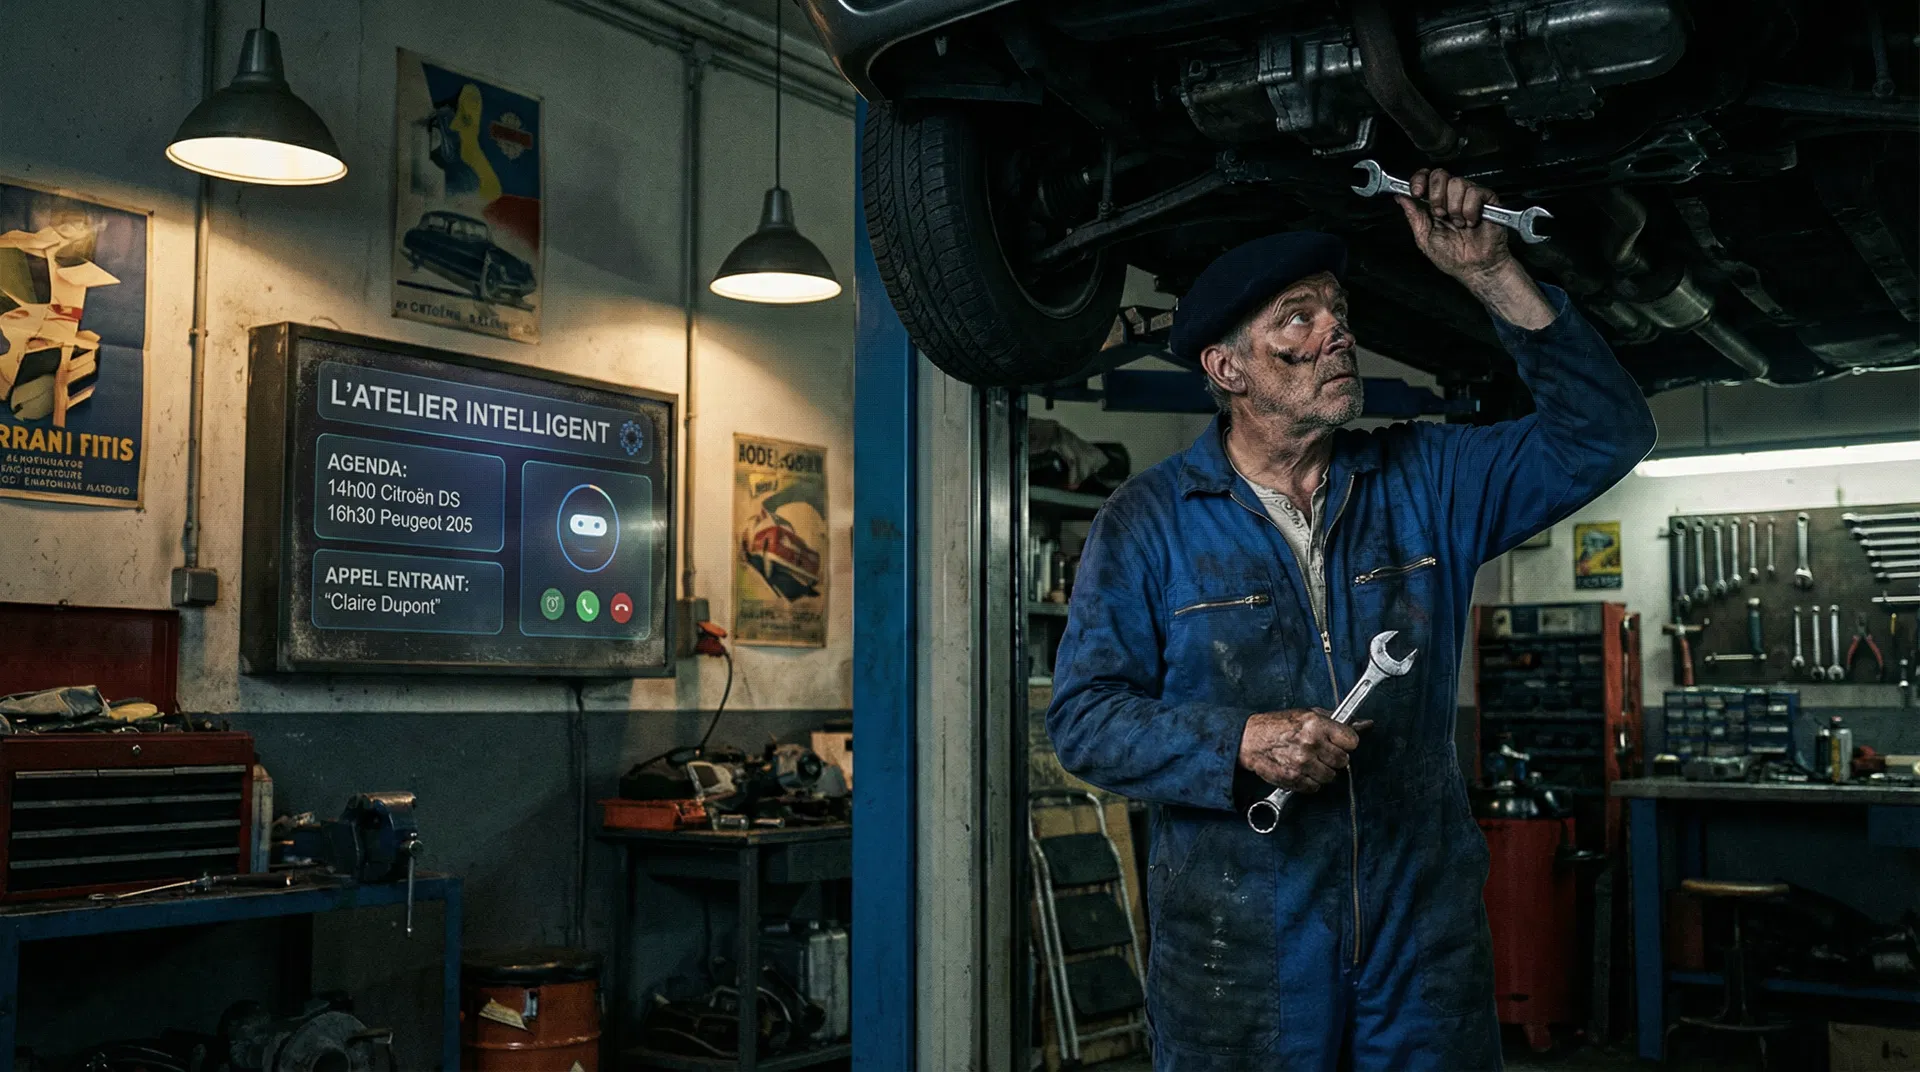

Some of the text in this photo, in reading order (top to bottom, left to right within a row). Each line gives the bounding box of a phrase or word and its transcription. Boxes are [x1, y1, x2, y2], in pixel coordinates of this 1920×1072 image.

[331, 379, 611, 444] L’ATELIER INTELLIGENT
[80, 433, 134, 462] FITIS
[327, 452, 408, 478] AGENDA:
[328, 478, 461, 508] 14h00 Citroën DS
[327, 503, 473, 534] 16h30 Peugeot 205
[325, 566, 470, 592] APPEL ENTRANT:
[324, 592, 441, 617] “Claire Dupont”
